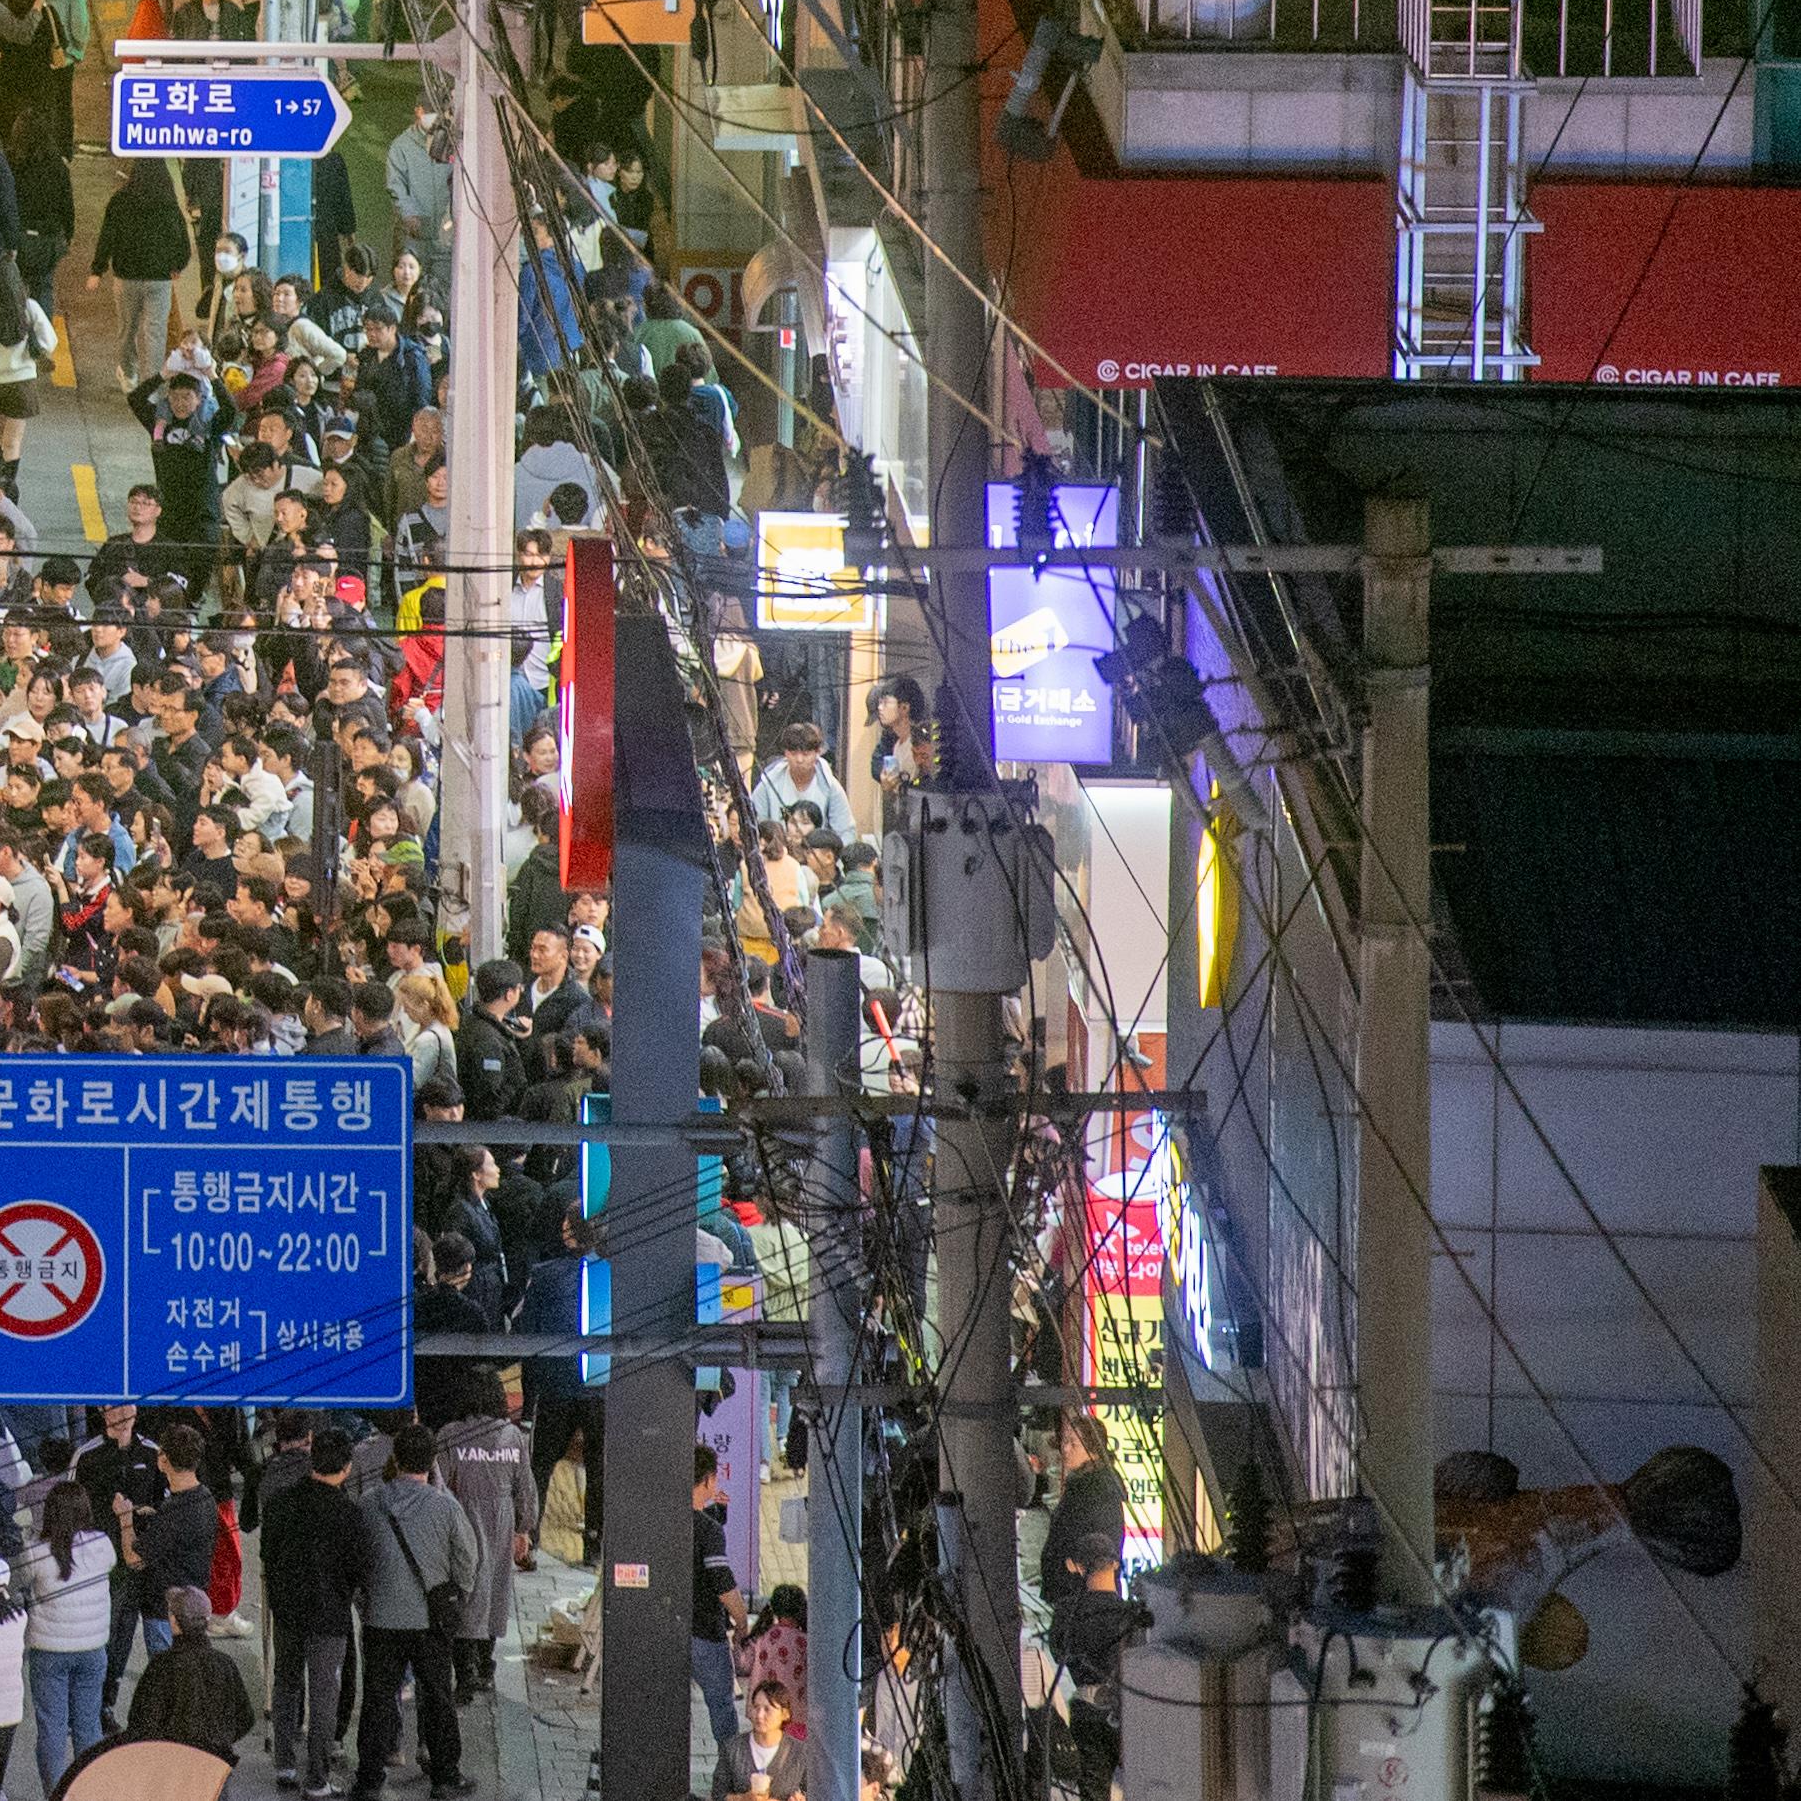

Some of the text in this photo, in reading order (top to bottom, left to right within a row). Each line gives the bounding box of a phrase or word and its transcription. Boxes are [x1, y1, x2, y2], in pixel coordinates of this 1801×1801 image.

[127, 81, 237, 119] 문화로
[126, 123, 253, 147] Munhwa-ro
[1124, 362, 1192, 380] CIGAR
[1624, 367, 1695, 386] CIGAR
[994, 687, 1097, 713] 금거래소
[169, 1171, 360, 1215] 통행금지시간
[170, 1231, 361, 1274] 10:00~22:00
[165, 1296, 242, 1330] 자전거
[275, 1320, 365, 1352] 상시허용
[165, 1339, 242, 1374] 손수레
